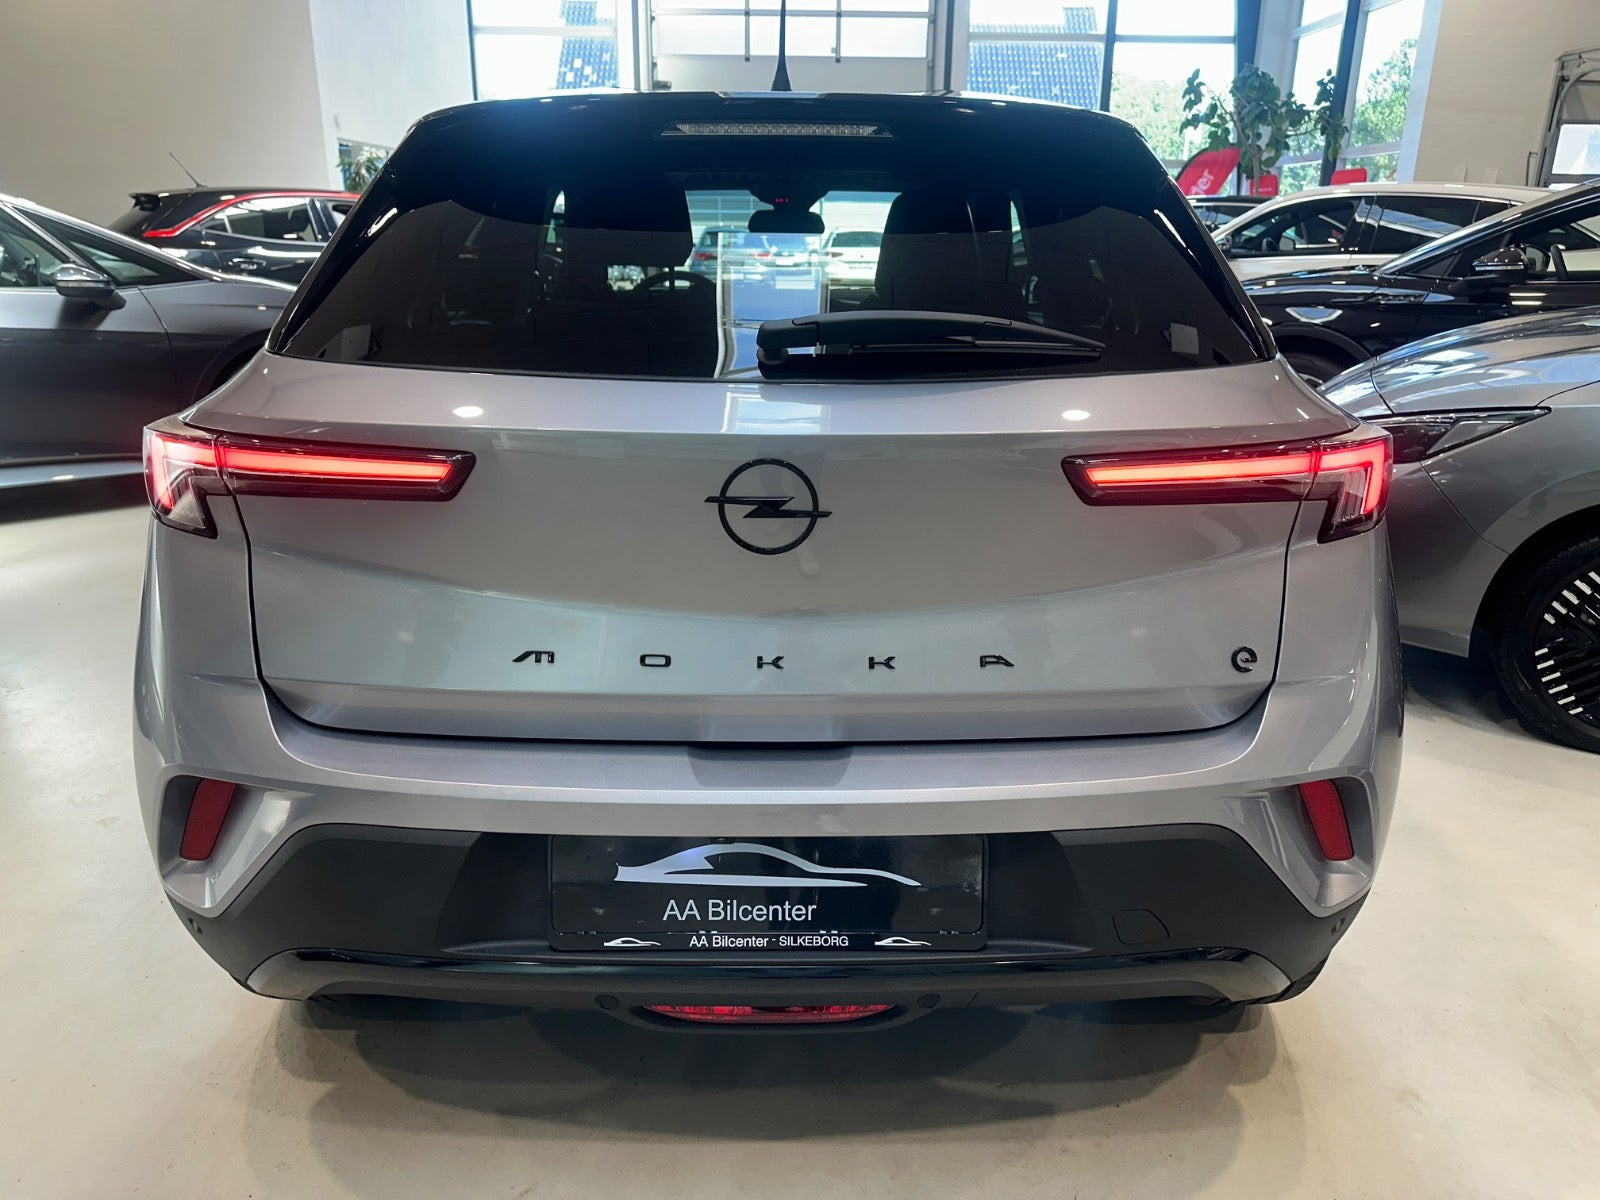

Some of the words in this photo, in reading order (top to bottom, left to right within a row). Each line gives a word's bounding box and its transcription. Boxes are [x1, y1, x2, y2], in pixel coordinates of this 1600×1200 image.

[512, 650, 1015, 669] MOKKA
[1231, 646, 1258, 673] e
[662, 899, 701, 921] AA
[708, 899, 817, 921] Bilcenter
[689, 935, 709, 948] AA
[711, 935, 769, 948] Bilcenter
[778, 935, 850, 947] SILKEBORG
